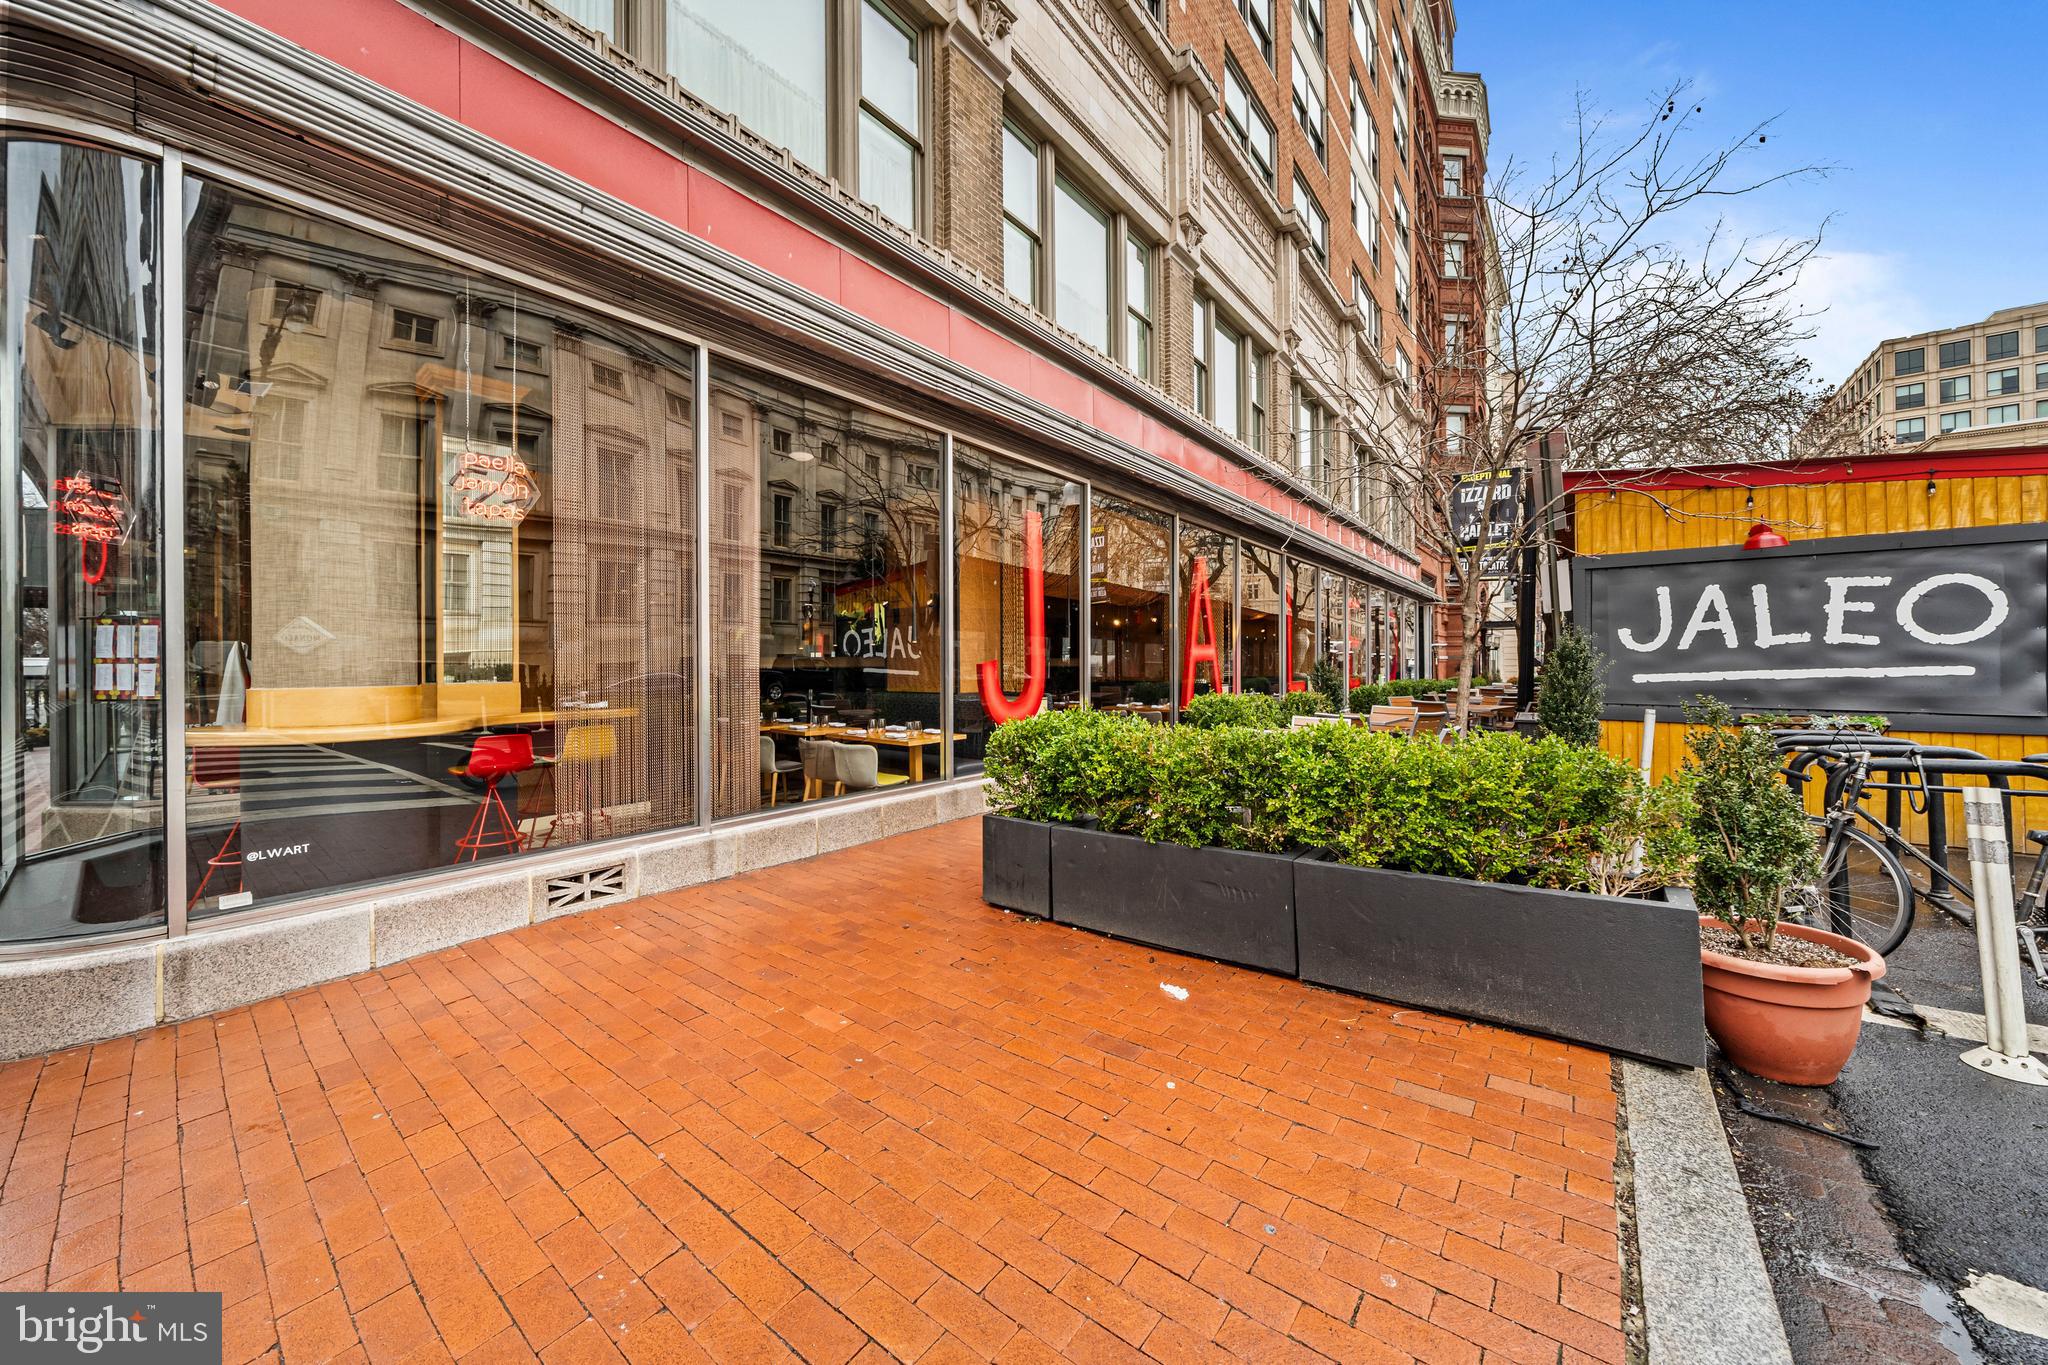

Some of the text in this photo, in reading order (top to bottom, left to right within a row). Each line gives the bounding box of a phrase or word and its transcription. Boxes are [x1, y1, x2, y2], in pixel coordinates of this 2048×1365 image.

[1461, 469, 1513, 482] EXCEPTINAL
[462, 496, 525, 520] tapas
[1617, 573, 2009, 652] JALEO
[246, 843, 310, 862] @LWART
